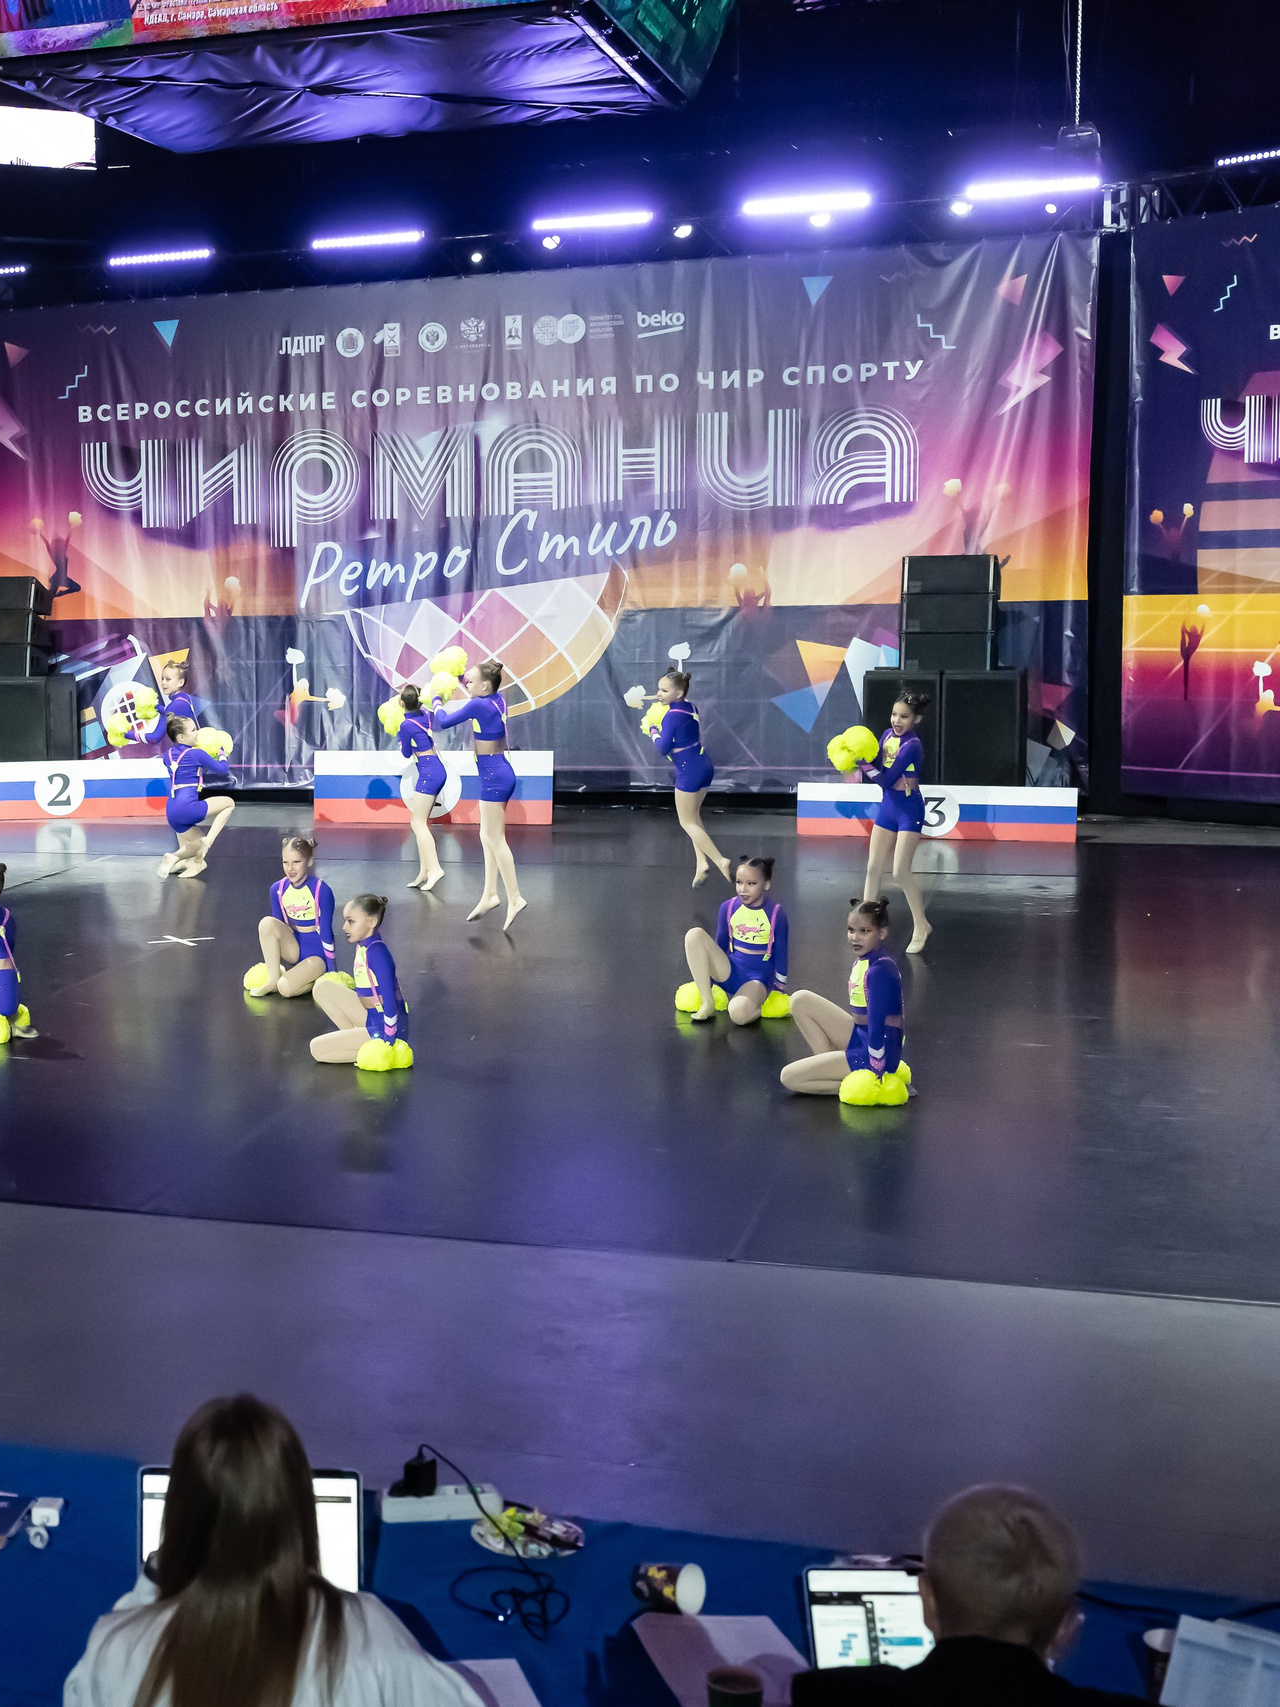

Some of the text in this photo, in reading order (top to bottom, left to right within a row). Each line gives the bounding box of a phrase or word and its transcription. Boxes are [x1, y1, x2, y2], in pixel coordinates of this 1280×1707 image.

[636, 309, 685, 328] beko
[279, 335, 326, 356] ЛДПР
[77, 360, 924, 423] ВСЕРОССИЙСКИЕ СОРЕВНОВАНИЯ ПО ЧИР СПОРТУ
[299, 509, 677, 608] Ретро Стиль
[47, 773, 72, 807] 2
[923, 796, 947, 828] 3
